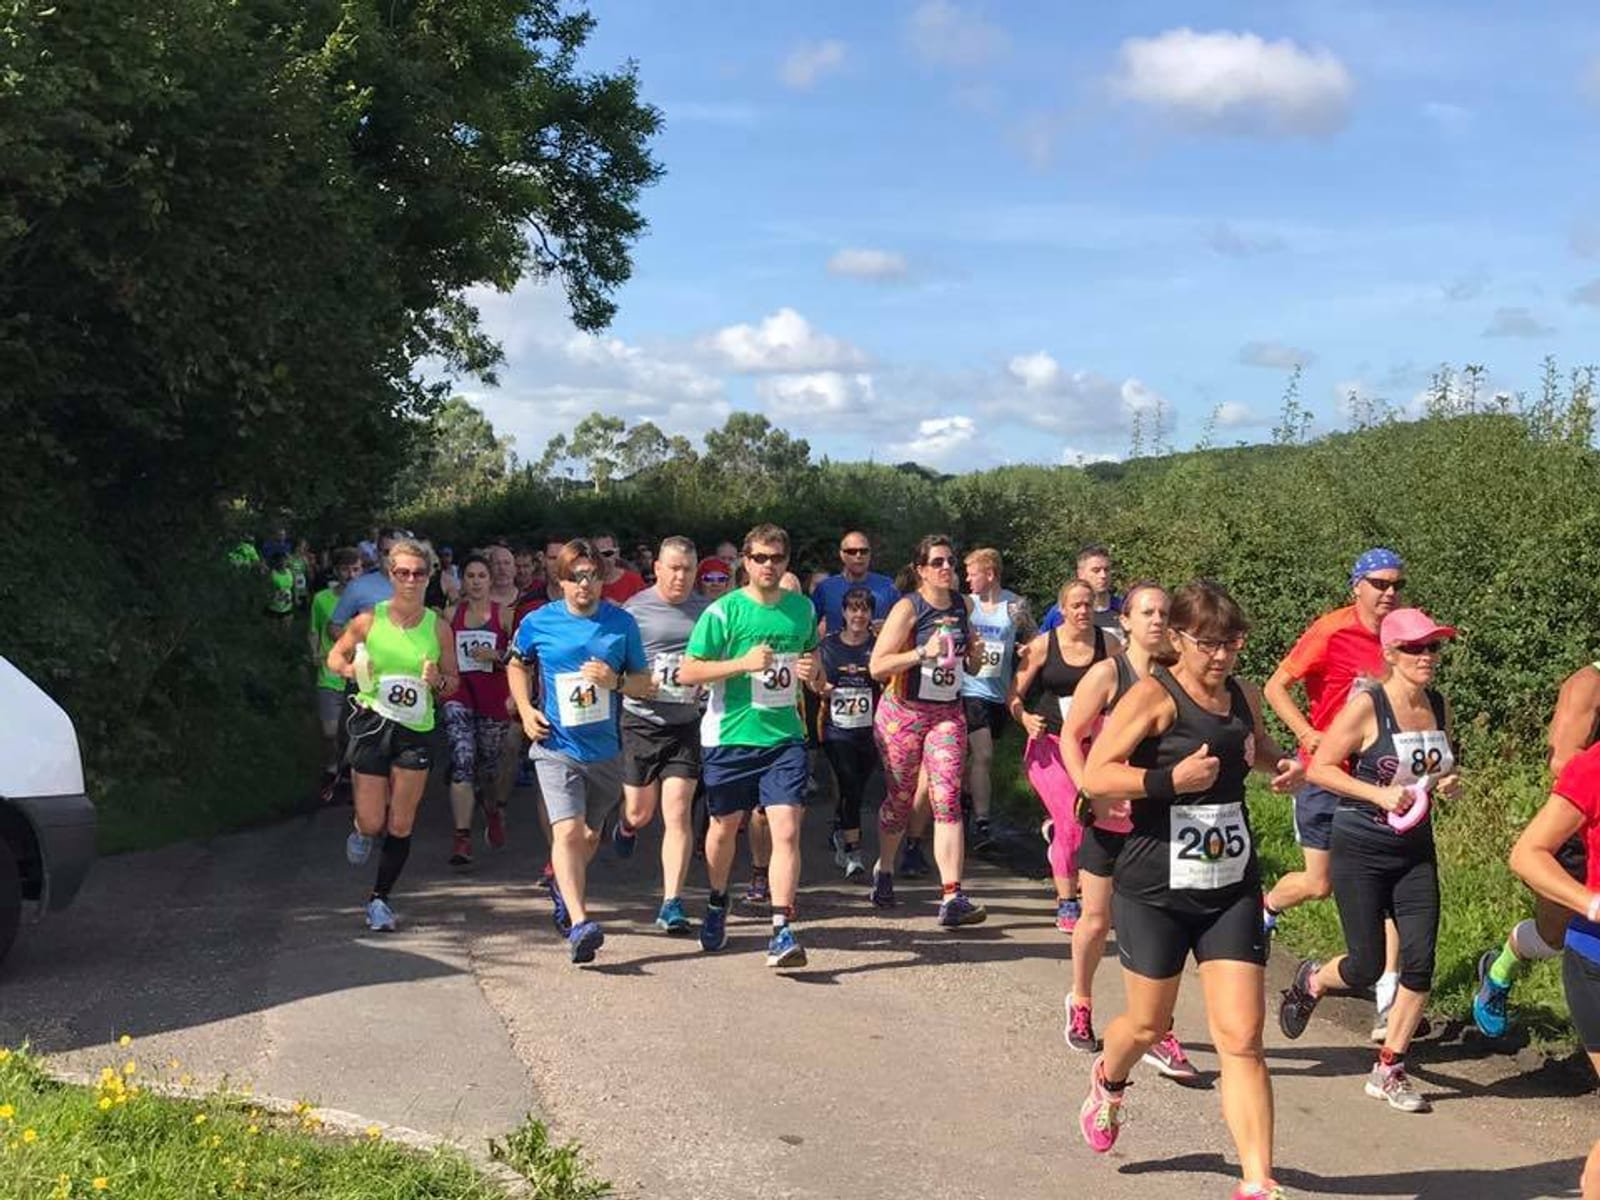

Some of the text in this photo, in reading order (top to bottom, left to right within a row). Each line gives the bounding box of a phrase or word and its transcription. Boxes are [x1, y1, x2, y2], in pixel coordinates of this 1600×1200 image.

[763, 666, 791, 690] 30
[932, 666, 956, 686] 65
[388, 684, 418, 708] 89
[569, 684, 597, 708] 41
[834, 697, 870, 716] 279
[1411, 747, 1442, 777] 82
[1177, 823, 1245, 860] 205
